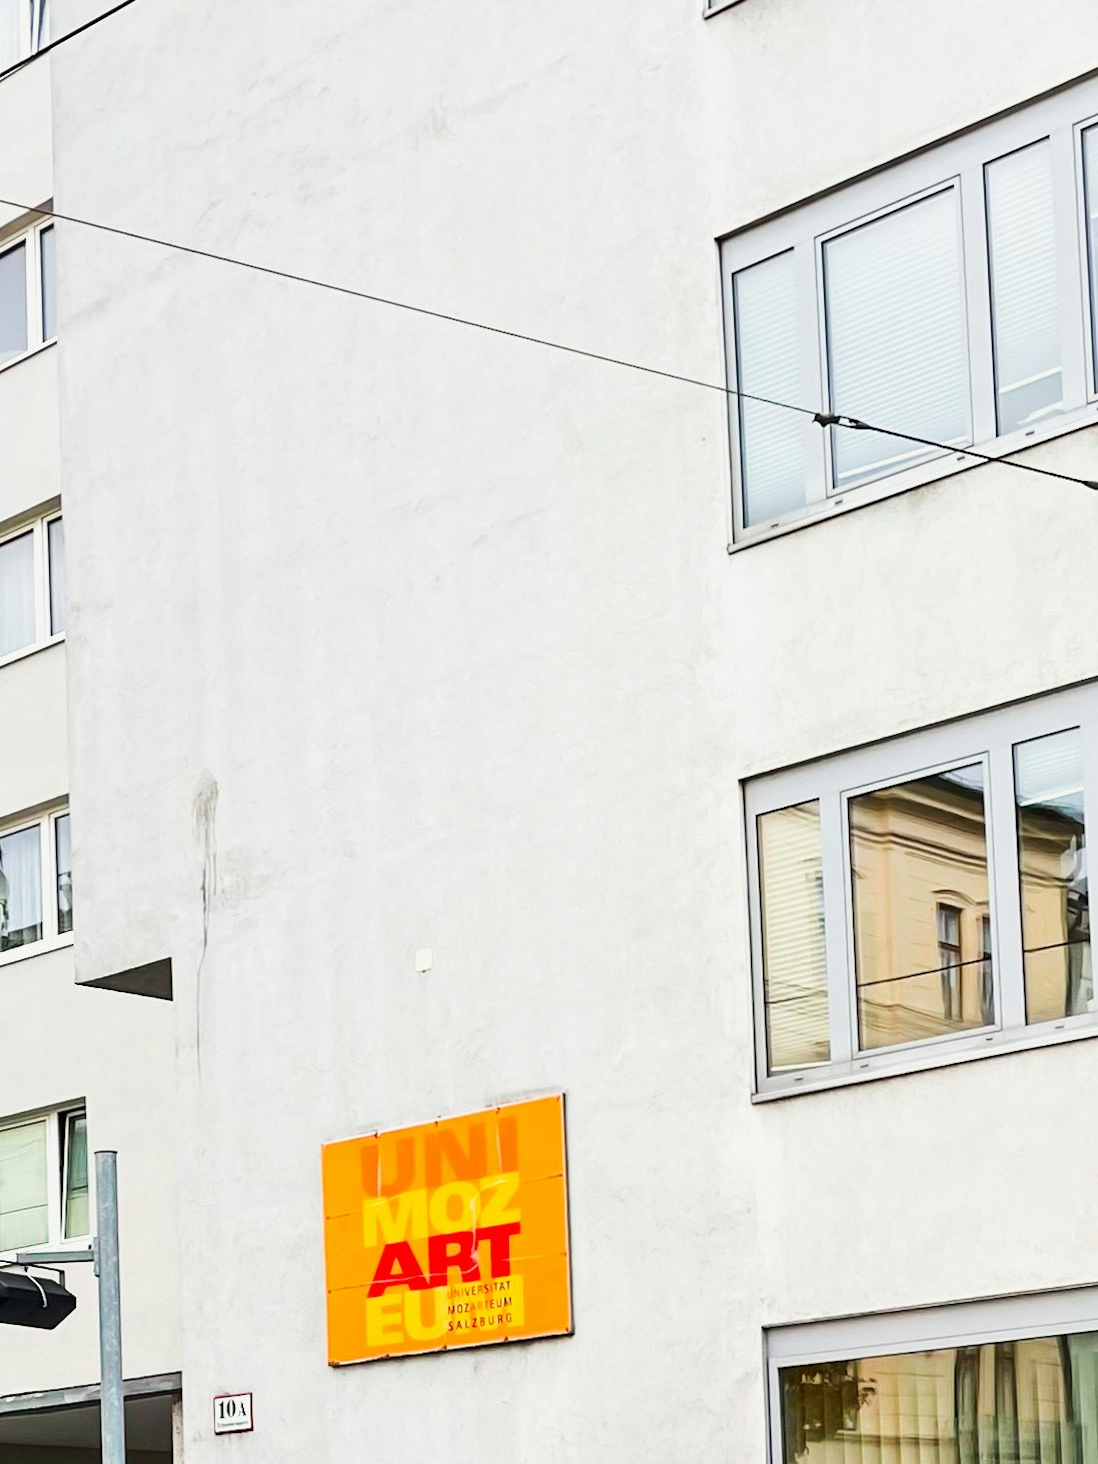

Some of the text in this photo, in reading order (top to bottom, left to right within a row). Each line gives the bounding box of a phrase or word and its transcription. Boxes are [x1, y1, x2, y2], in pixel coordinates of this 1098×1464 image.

[361, 1115, 517, 1198] UNI
[363, 1172, 521, 1247] MOZ
[367, 1222, 521, 1298] ART
[447, 1297, 512, 1315] MOZARTEUM
[448, 1313, 512, 1331] SALZBURG
